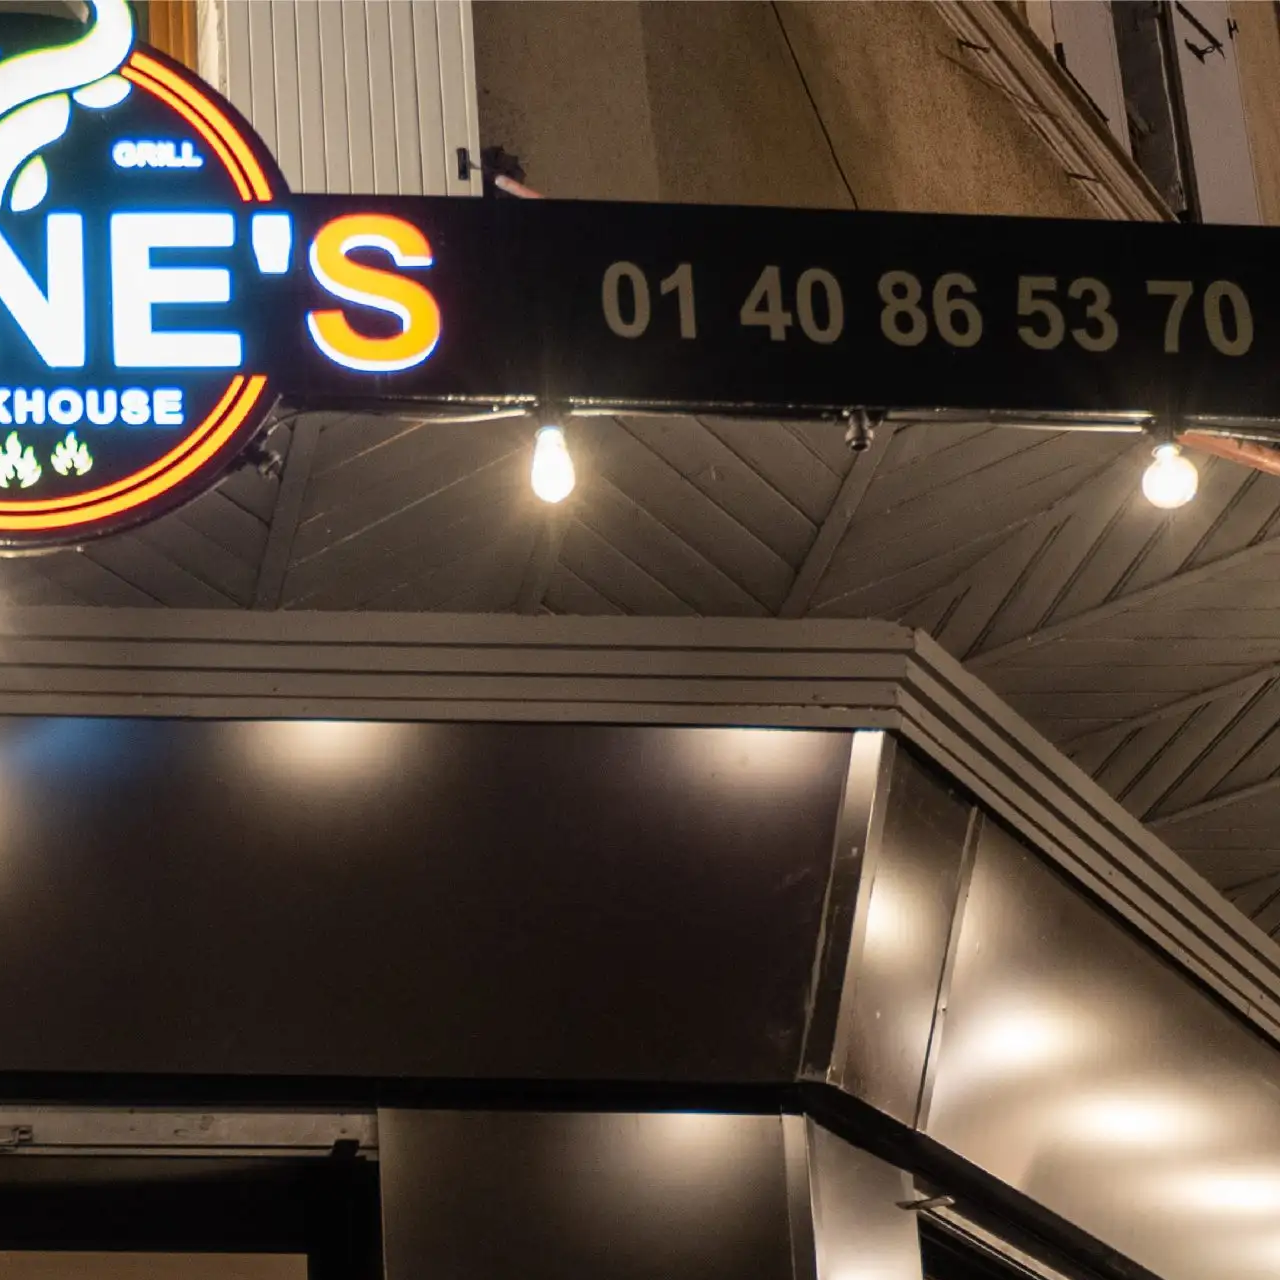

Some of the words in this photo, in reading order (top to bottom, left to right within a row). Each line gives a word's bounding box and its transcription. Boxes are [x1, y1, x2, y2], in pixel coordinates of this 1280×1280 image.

[113, 142, 204, 169] GRILL
[603, 261, 697, 339] 01
[740, 266, 844, 343] 40
[879, 271, 983, 347] 86
[1017, 276, 1119, 352] 53
[1147, 280, 1254, 356] 70
